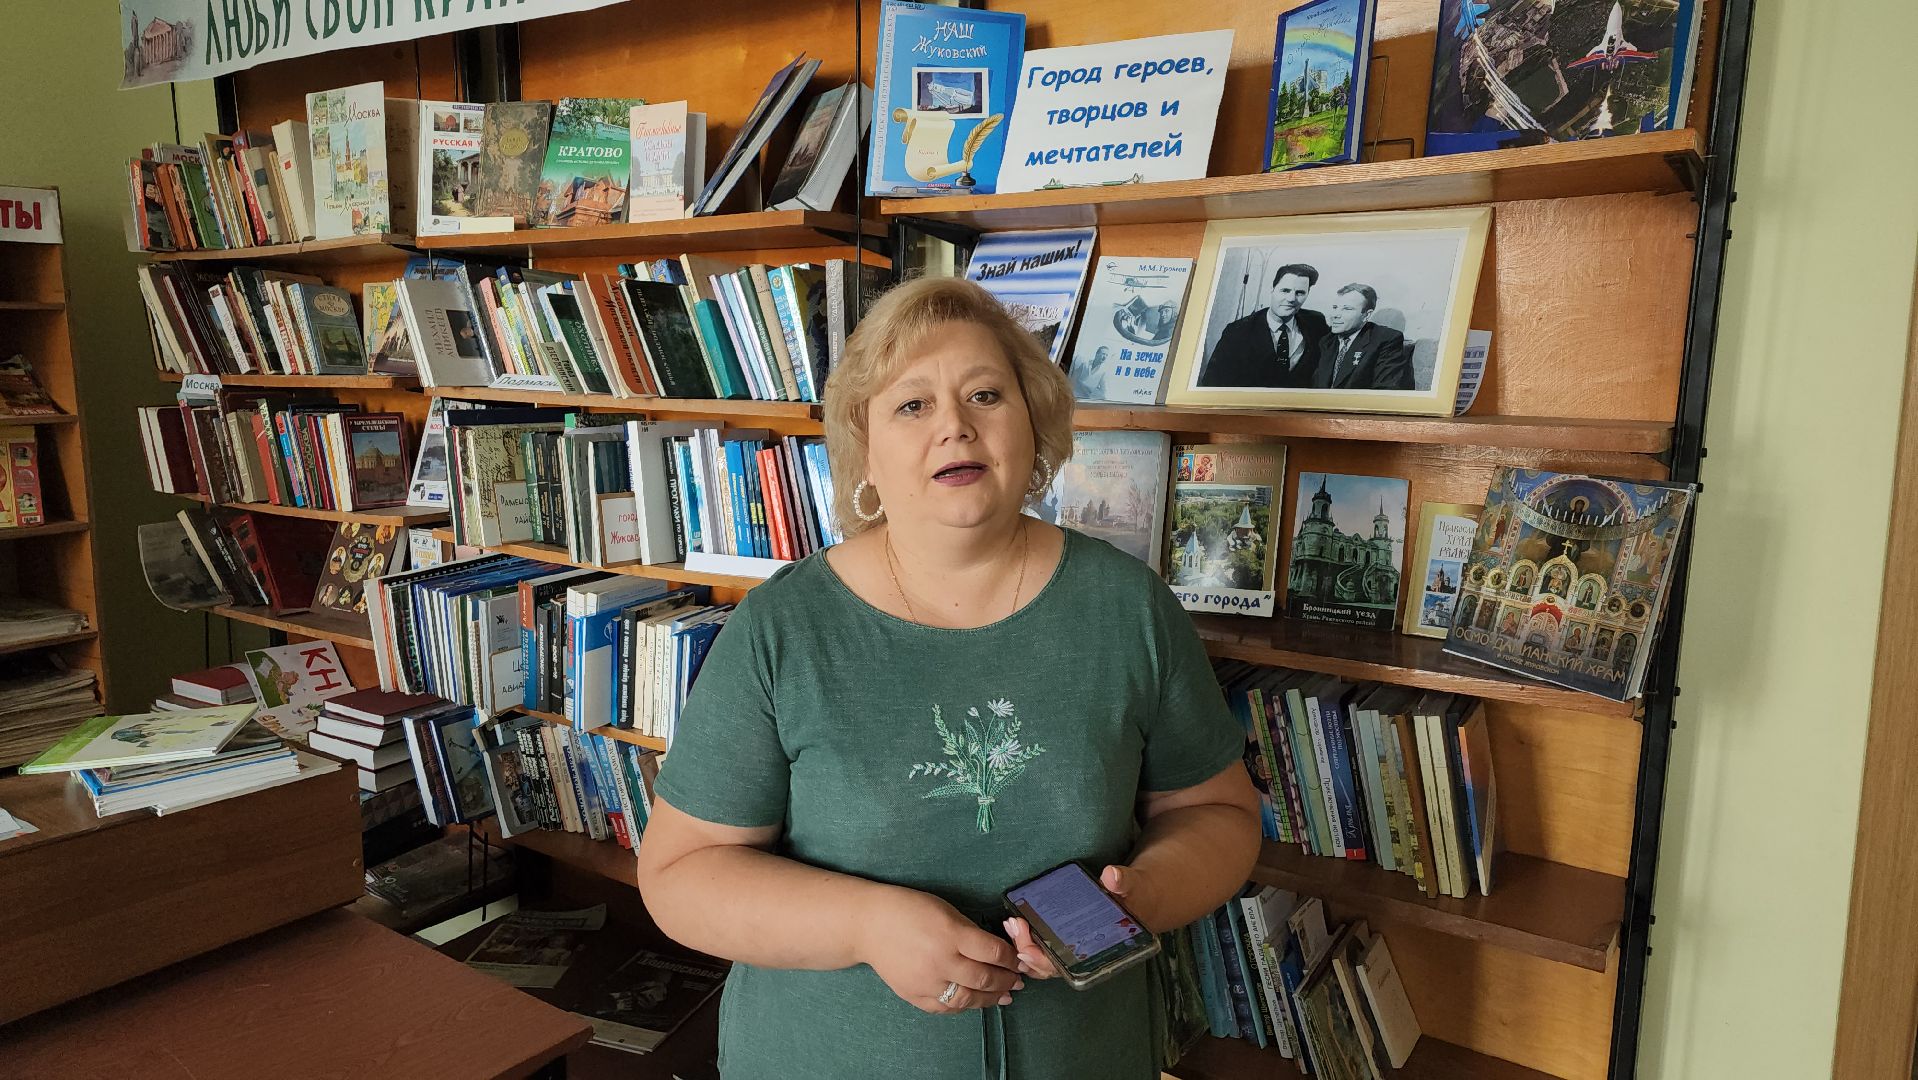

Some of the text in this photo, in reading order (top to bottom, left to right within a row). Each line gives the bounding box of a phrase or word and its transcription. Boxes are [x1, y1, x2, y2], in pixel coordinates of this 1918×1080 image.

[933, 20, 975, 41] НАШ
[1027, 55, 1214, 91] Город героев,
[1046, 99, 1180, 129] творцов и
[433, 138, 473, 147] РУССКАЯ
[557, 145, 623, 158] КРАТОВО
[1024, 132, 1184, 168] мечтателей
[975, 239, 1083, 282] Знай наших!
[1119, 348, 1164, 363] На земле
[1124, 366, 1131, 377] в
[1133, 366, 1157, 379] небе
[1586, 663, 1627, 685] ХРАМ
